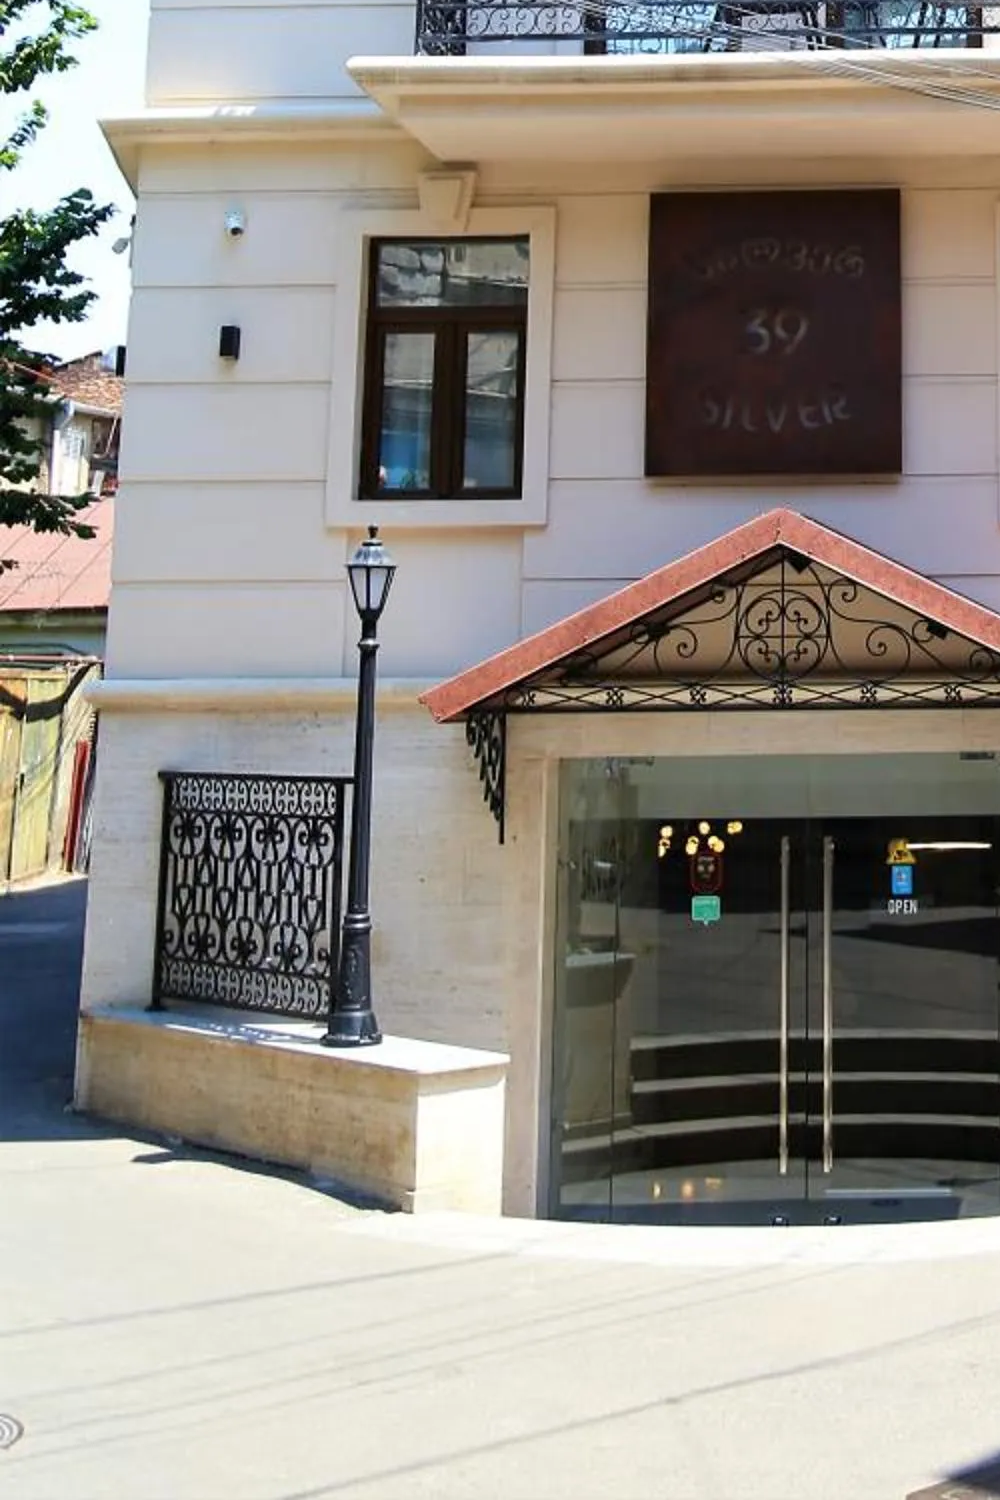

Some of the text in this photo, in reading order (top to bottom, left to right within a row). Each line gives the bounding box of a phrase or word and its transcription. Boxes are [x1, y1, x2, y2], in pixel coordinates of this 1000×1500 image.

[745, 305, 810, 356] 39
[701, 389, 853, 435] SILVER
[887, 898, 918, 915] OPEN
